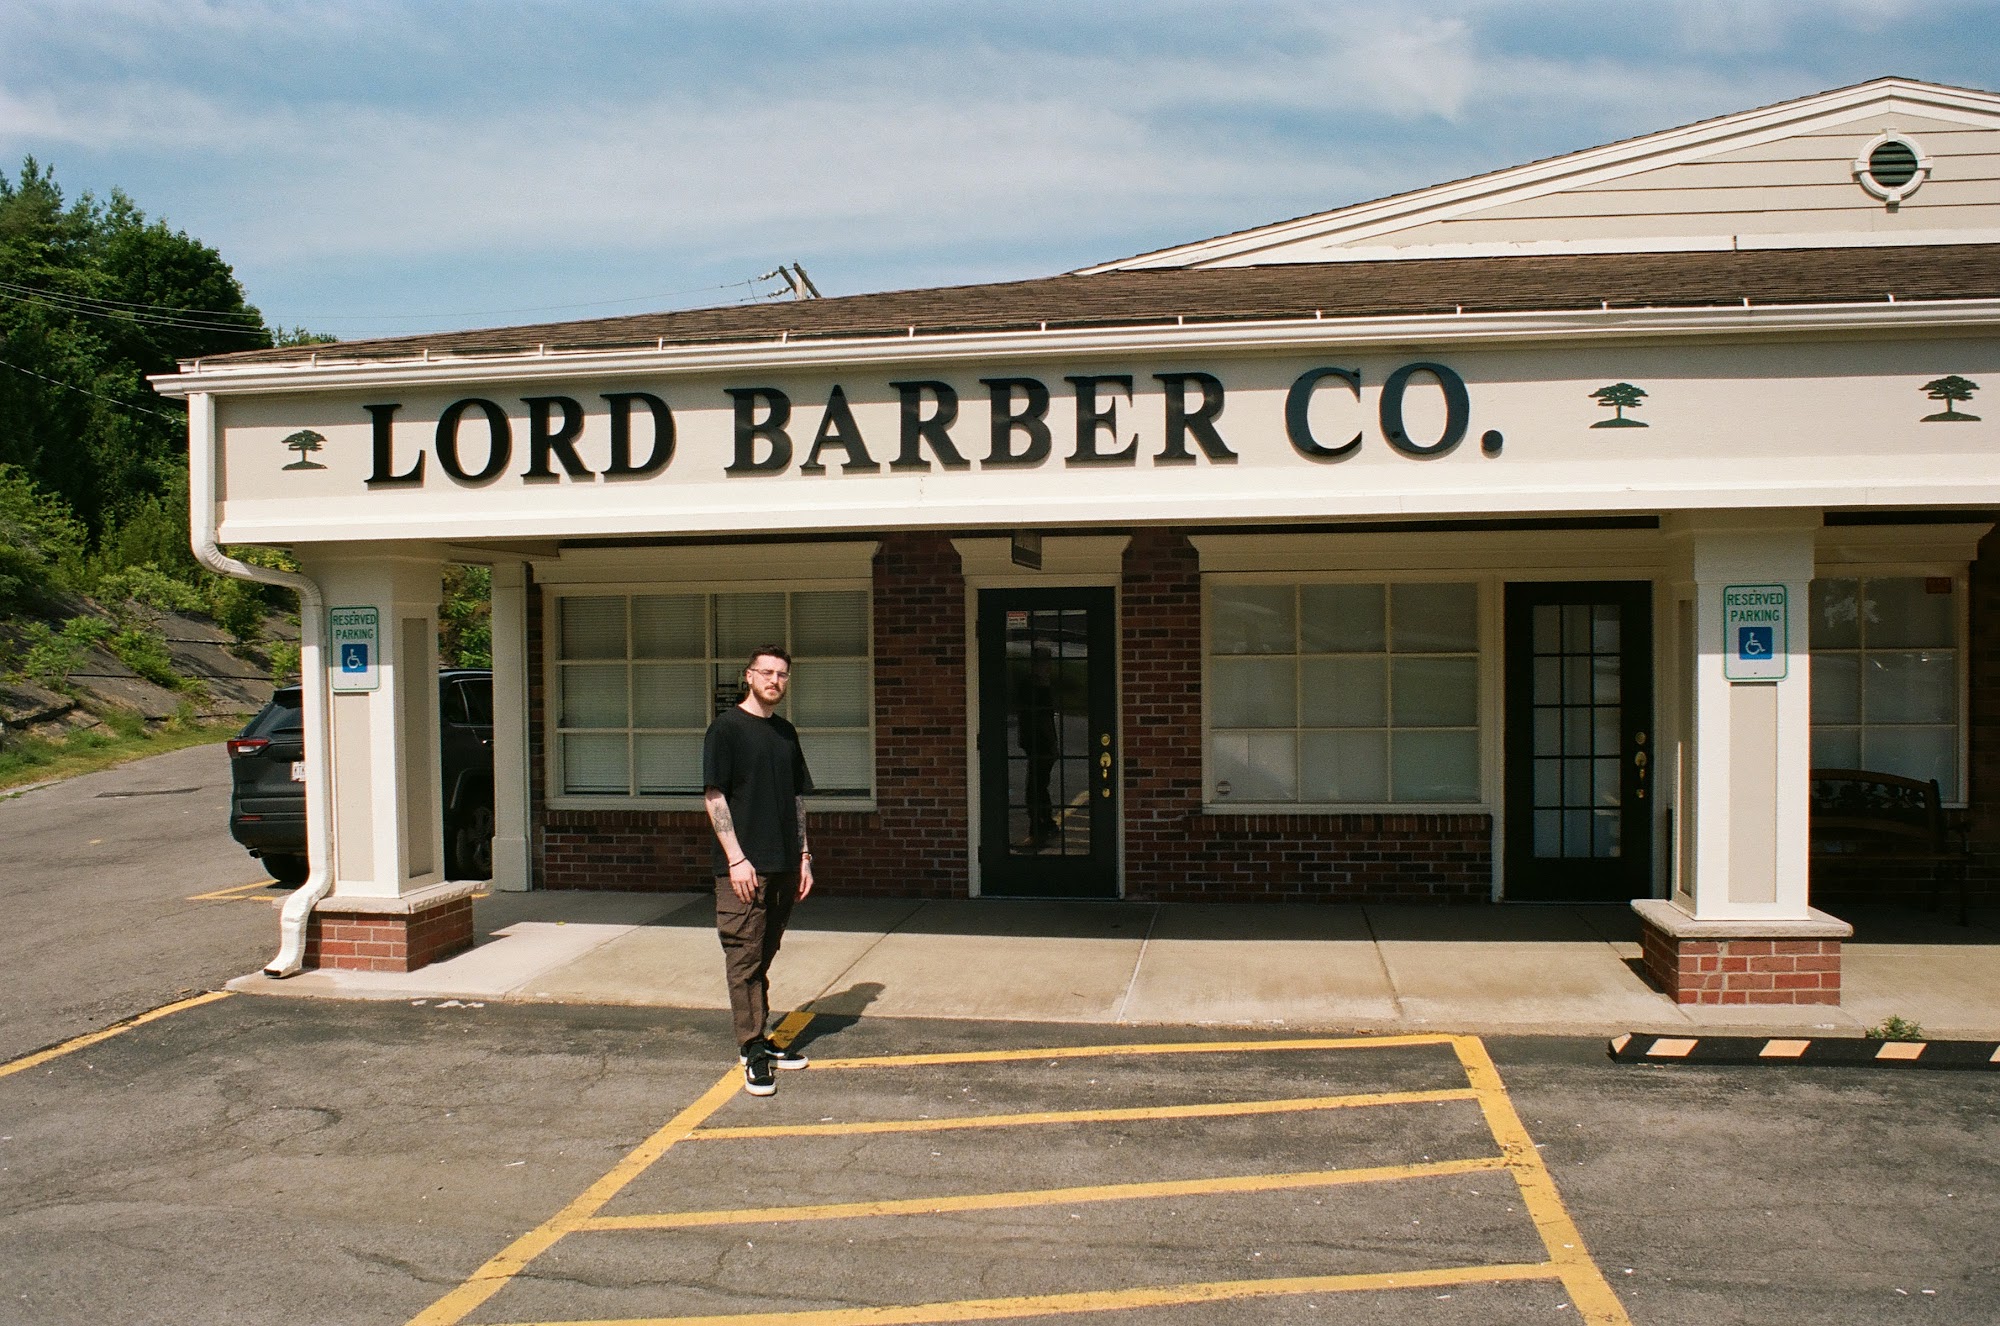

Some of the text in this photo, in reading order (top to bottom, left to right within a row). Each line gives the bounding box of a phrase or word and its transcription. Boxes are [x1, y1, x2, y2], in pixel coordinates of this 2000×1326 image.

[363, 362, 1503, 486] LORD BARBER CO.
[1727, 593, 1783, 605] RESERVED
[333, 614, 375, 625] RESERVED
[1731, 609, 1779, 621] PARKING
[335, 628, 374, 639] PARKING
